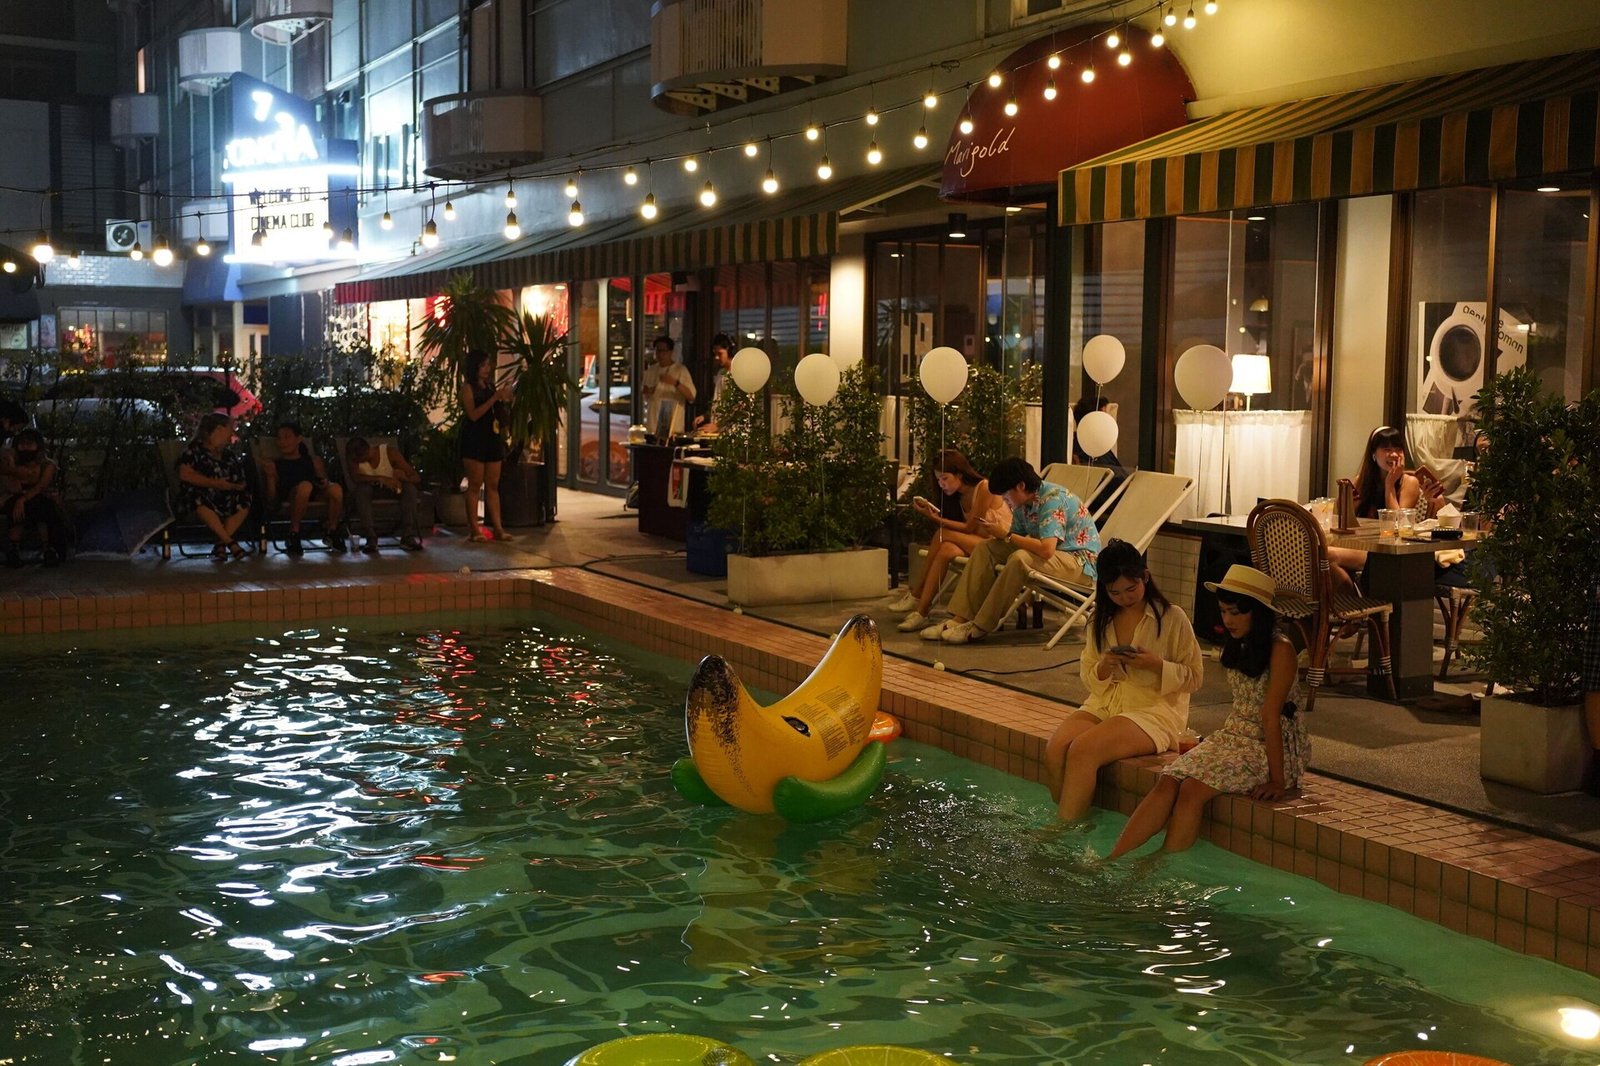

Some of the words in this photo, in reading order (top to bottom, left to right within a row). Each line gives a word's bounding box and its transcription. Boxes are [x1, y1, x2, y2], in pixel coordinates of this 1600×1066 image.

[944, 126, 1016, 178] Marigold
[291, 213, 314, 228] CLUB
[1497, 330, 1524, 355] oman
